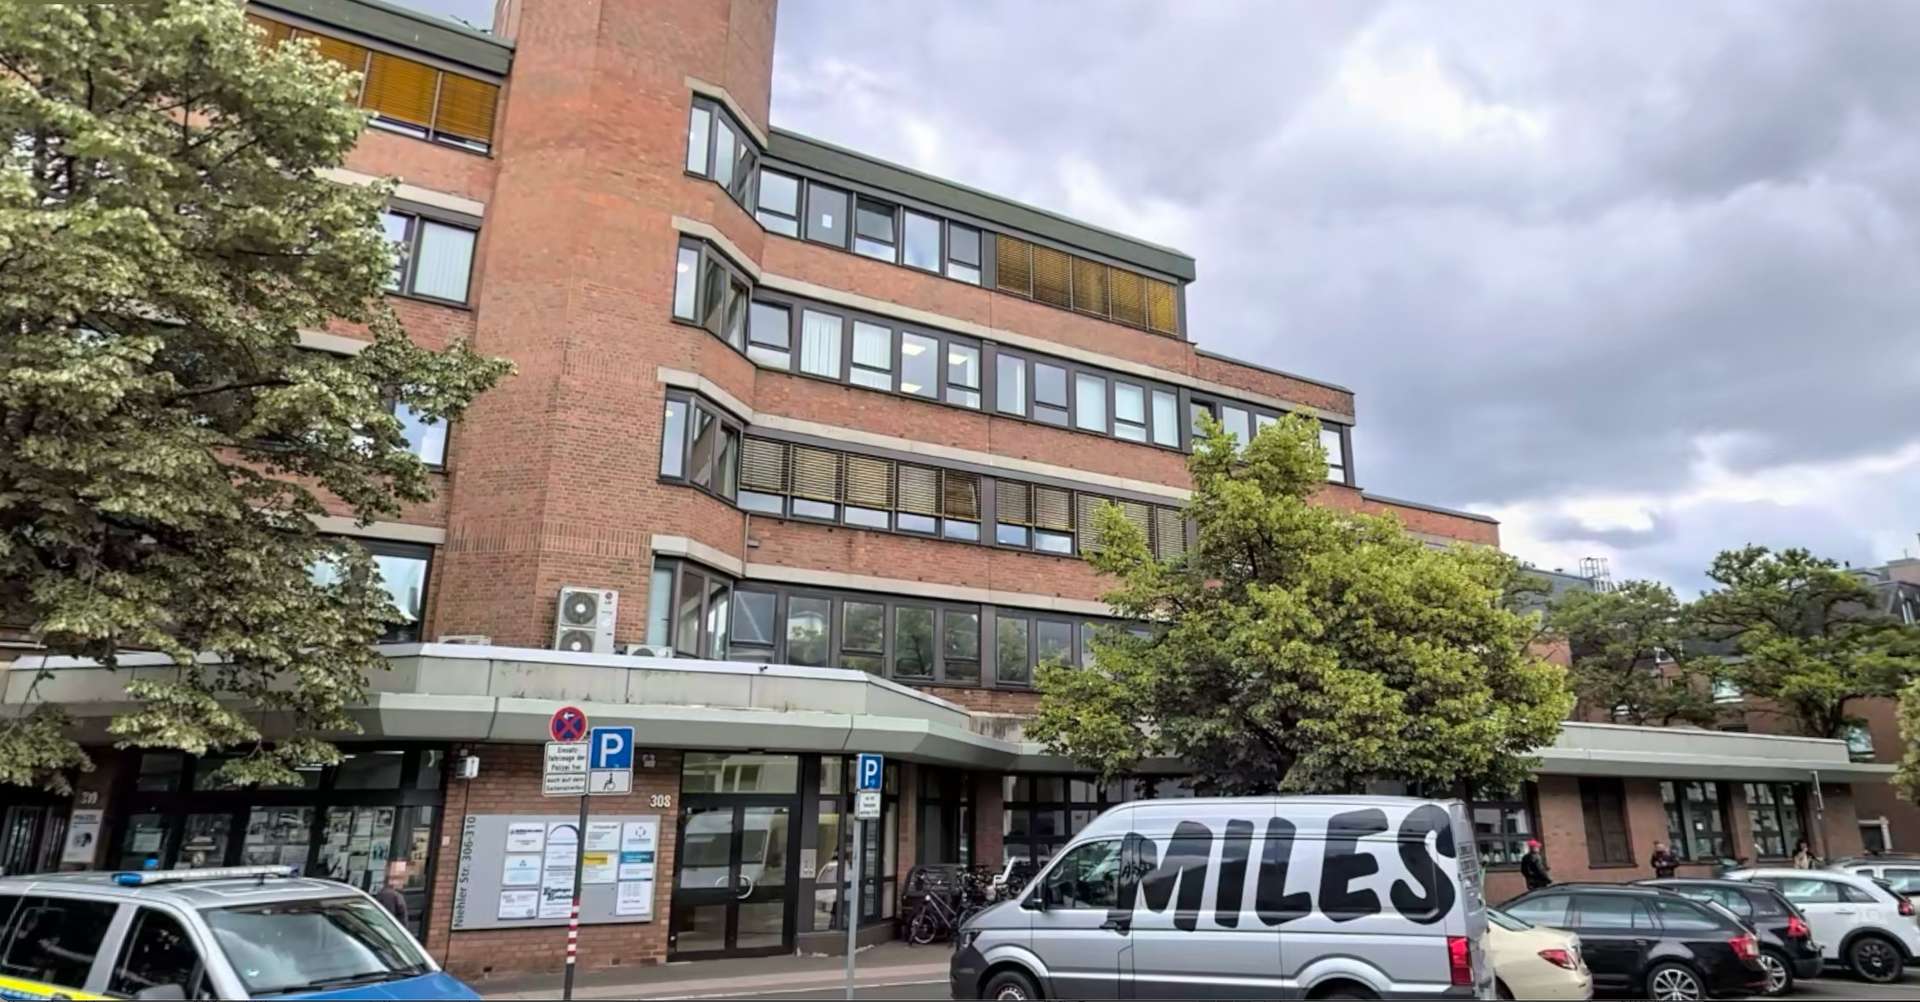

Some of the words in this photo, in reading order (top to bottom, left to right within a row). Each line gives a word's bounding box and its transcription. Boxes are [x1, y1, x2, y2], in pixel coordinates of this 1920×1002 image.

[600, 733, 624, 767] P
[865, 759, 878, 787] P
[649, 794, 672, 808] 308
[453, 886, 467, 928] Niehler
[462, 816, 477, 862] 306-310
[1106, 804, 1456, 936] MILES
